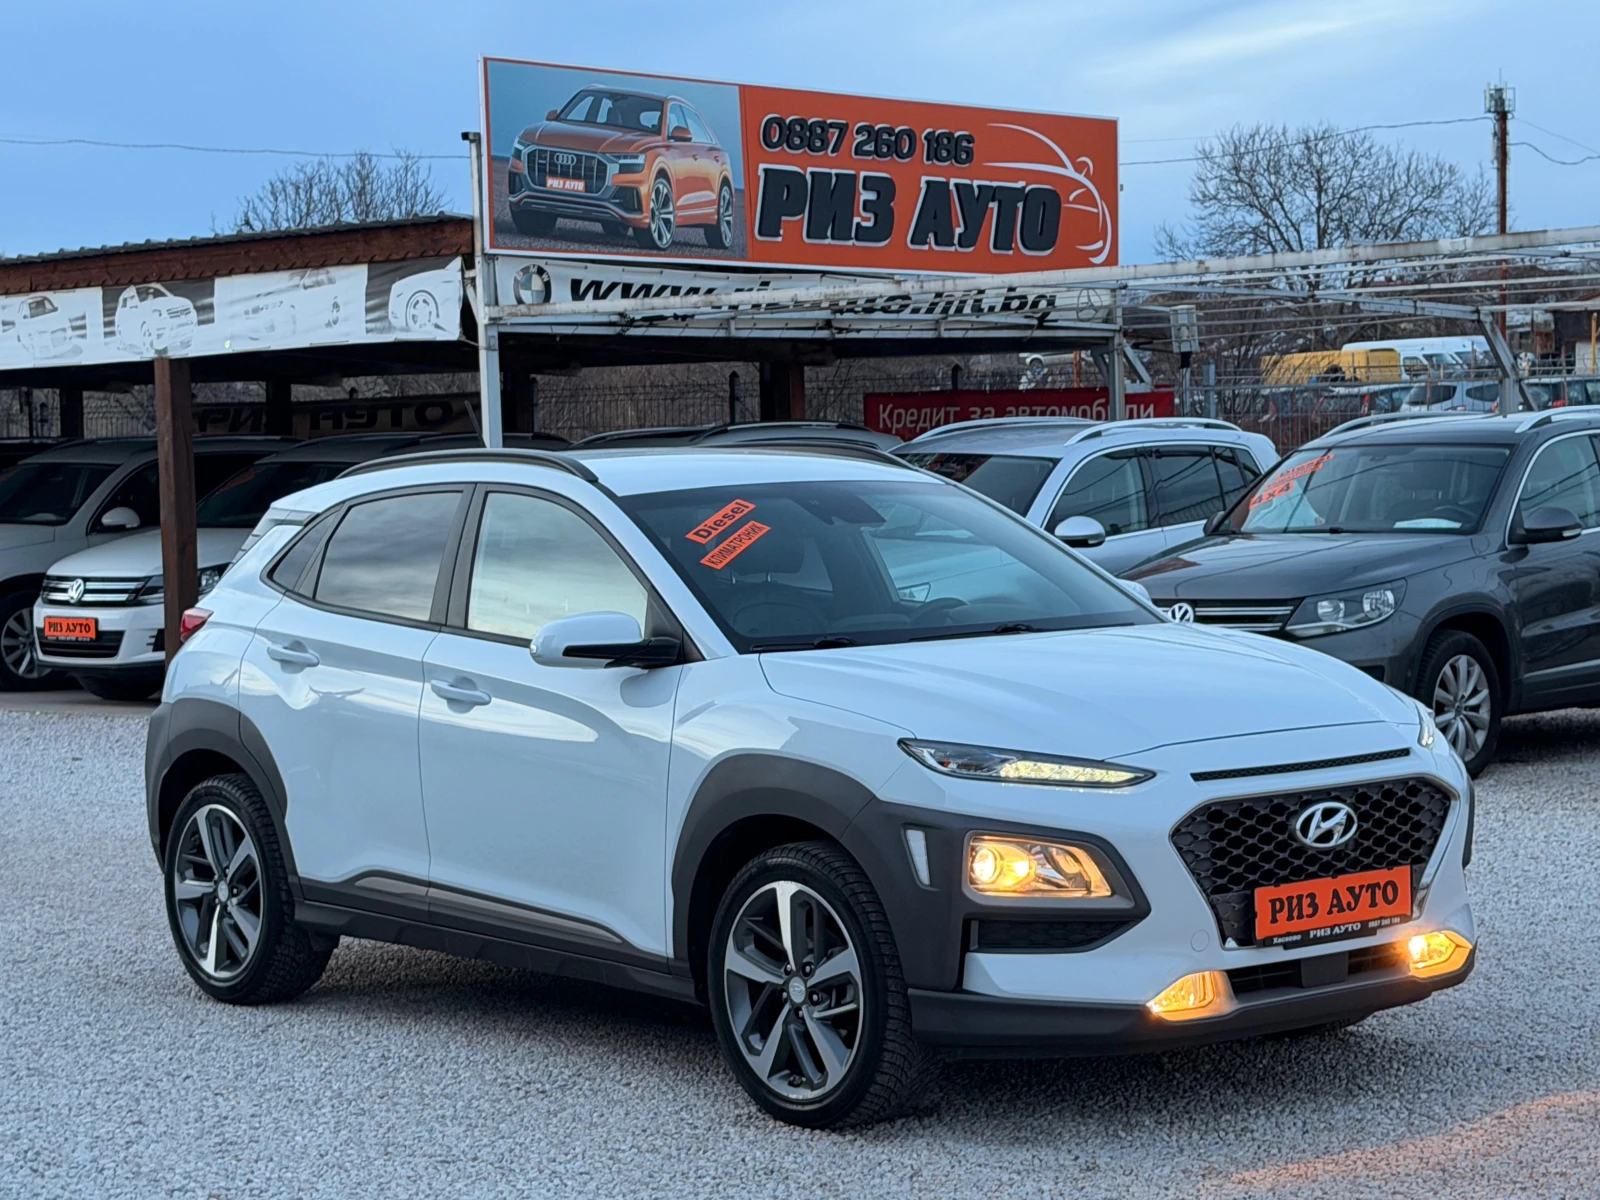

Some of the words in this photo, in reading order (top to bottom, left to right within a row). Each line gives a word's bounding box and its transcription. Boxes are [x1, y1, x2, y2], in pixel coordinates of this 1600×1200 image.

[760, 114, 849, 156] 0887
[852, 121, 917, 162] 260
[922, 128, 976, 167] 186
[756, 164, 897, 246] РИЗ
[908, 176, 1062, 256] АУТО
[198, 407, 266, 433] РИ
[879, 403, 960, 432] Кредит
[969, 407, 995, 420] за
[1004, 398, 1155, 419] автомобли
[692, 501, 750, 540] Diesel
[706, 522, 765, 566] КЛИМАТРОНИК
[65, 622, 91, 634] АУТО
[1269, 892, 1319, 924] РИЗ
[1327, 880, 1399, 915] АУТО
[1309, 927, 1331, 939] РИЗ
[1332, 922, 1361, 935] АУТО
